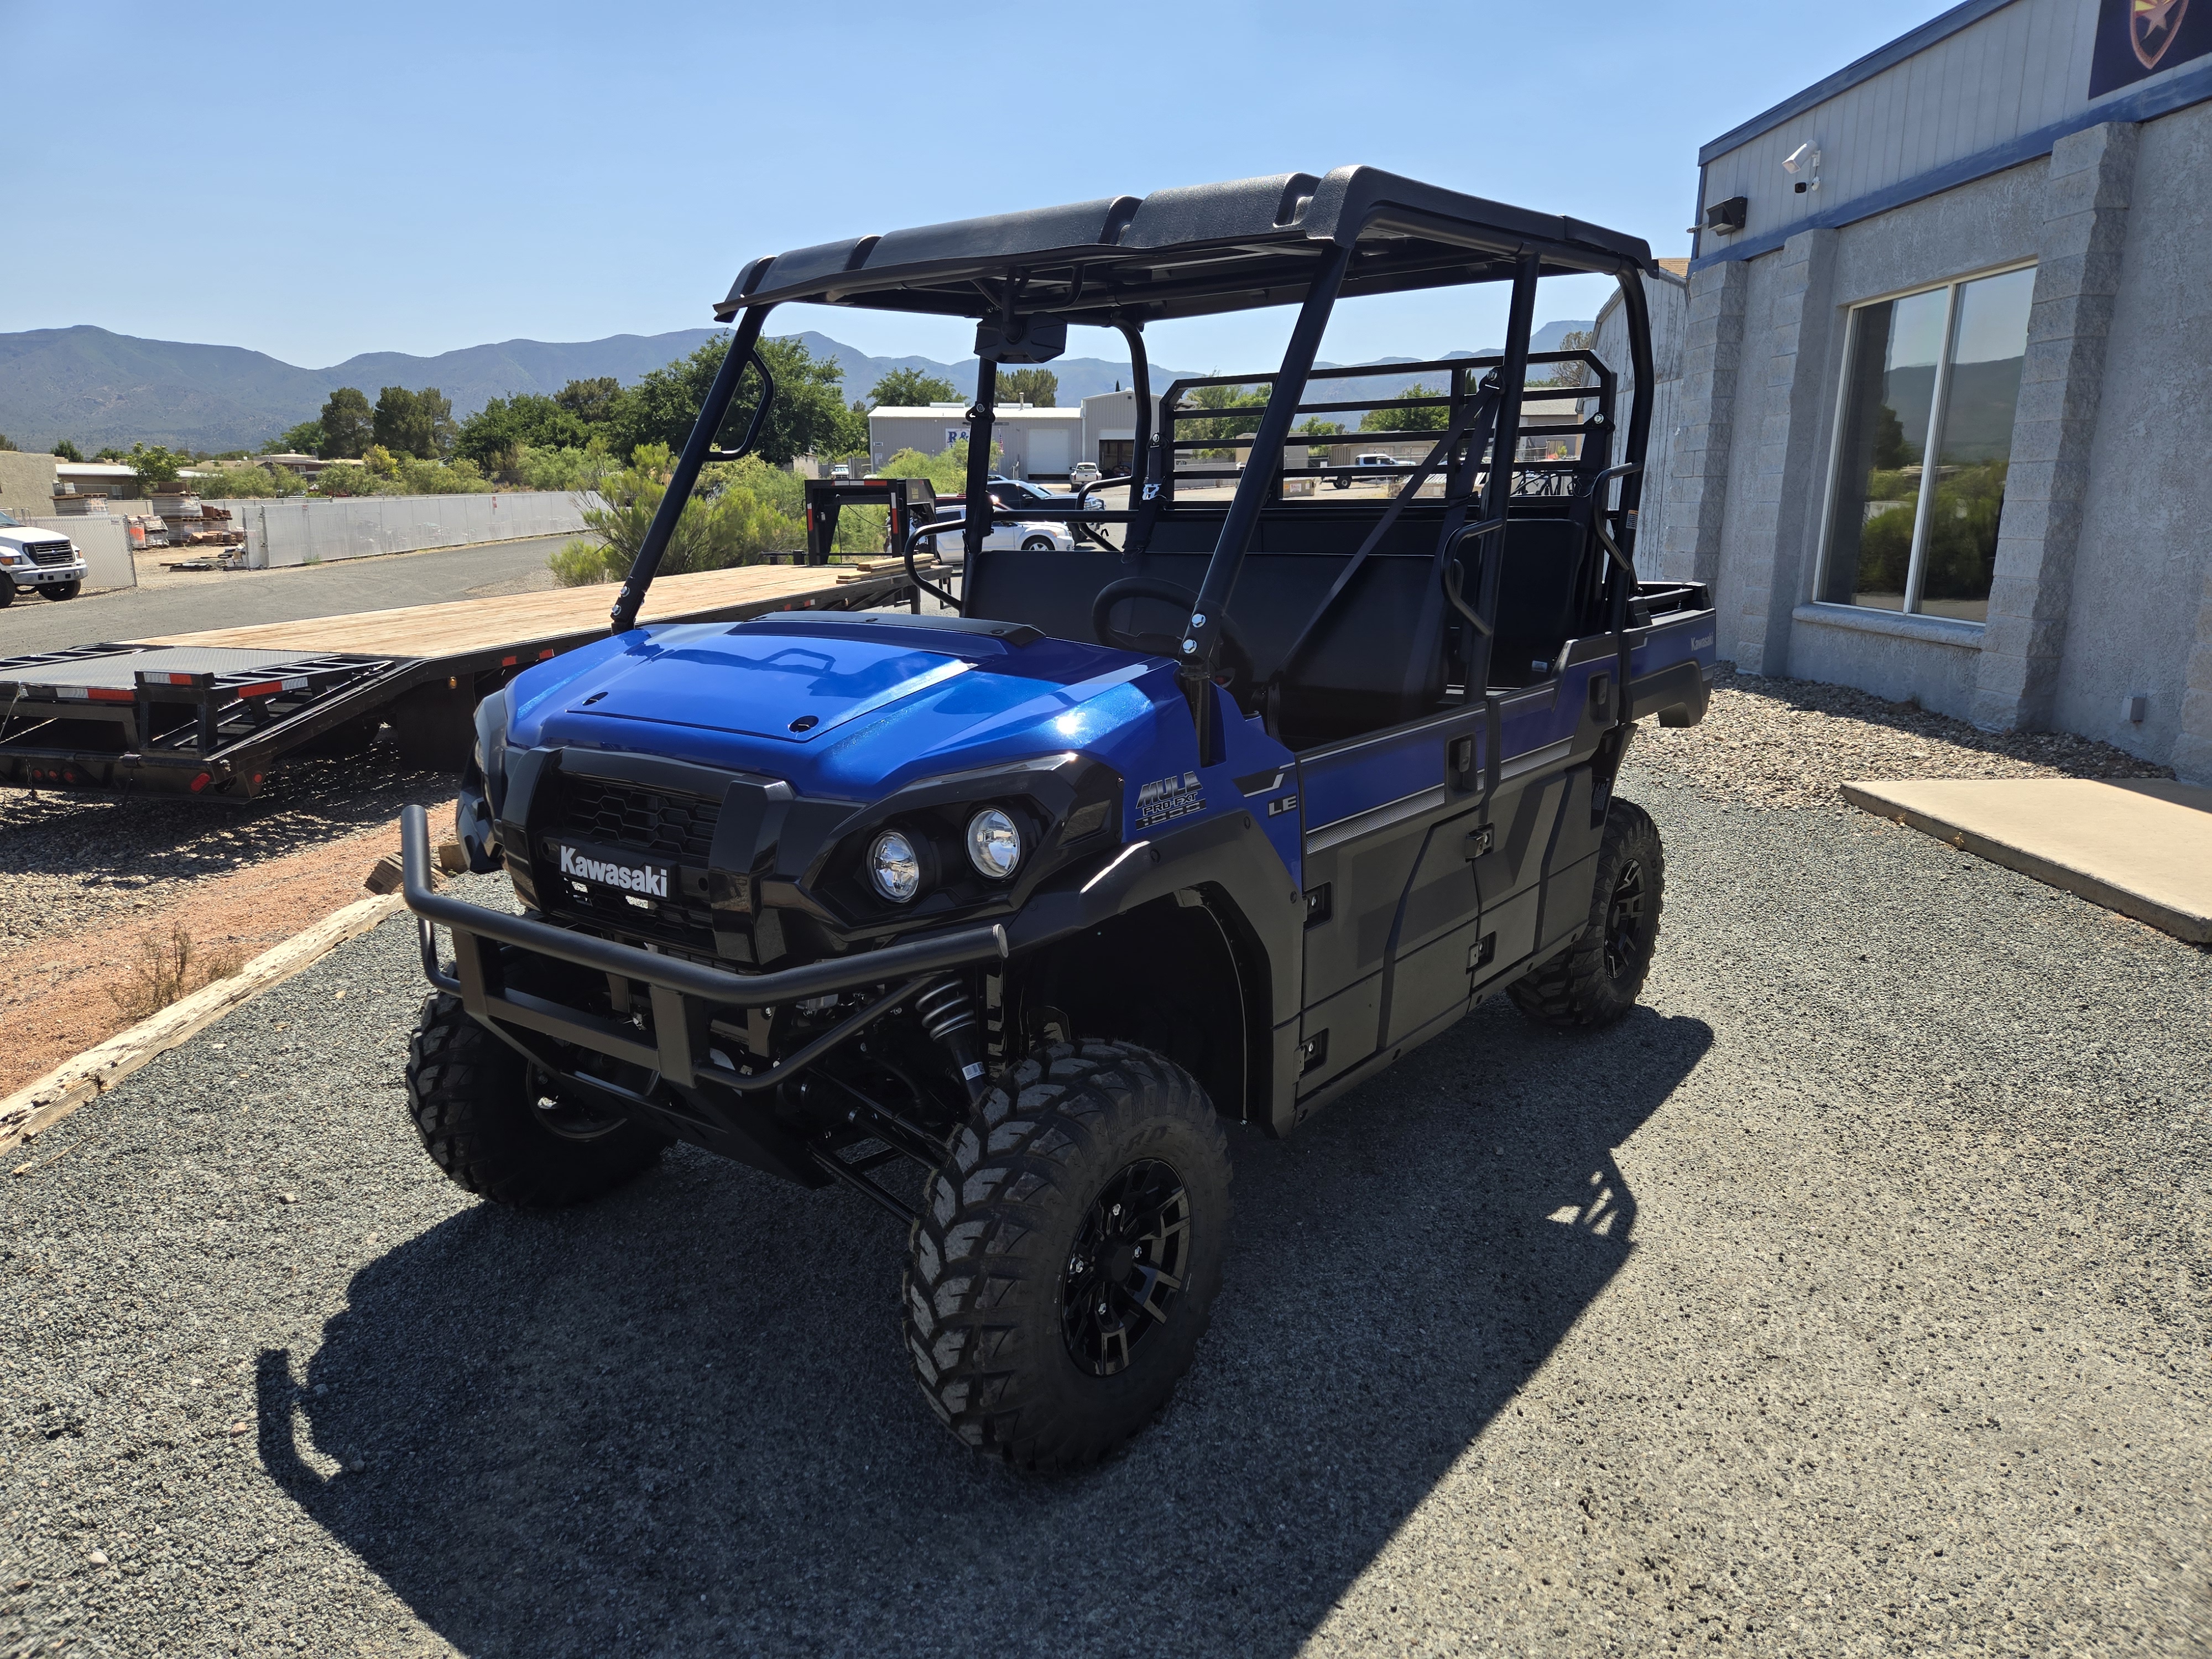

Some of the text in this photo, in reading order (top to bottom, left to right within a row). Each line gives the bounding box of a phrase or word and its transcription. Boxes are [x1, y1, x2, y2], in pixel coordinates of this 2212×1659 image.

[947, 431, 957, 443] R
[1135, 770, 1203, 809] MULE
[1142, 791, 1198, 816] PRO-FXT
[1269, 795, 1296, 816] LE
[561, 845, 667, 898] Kawasaki
